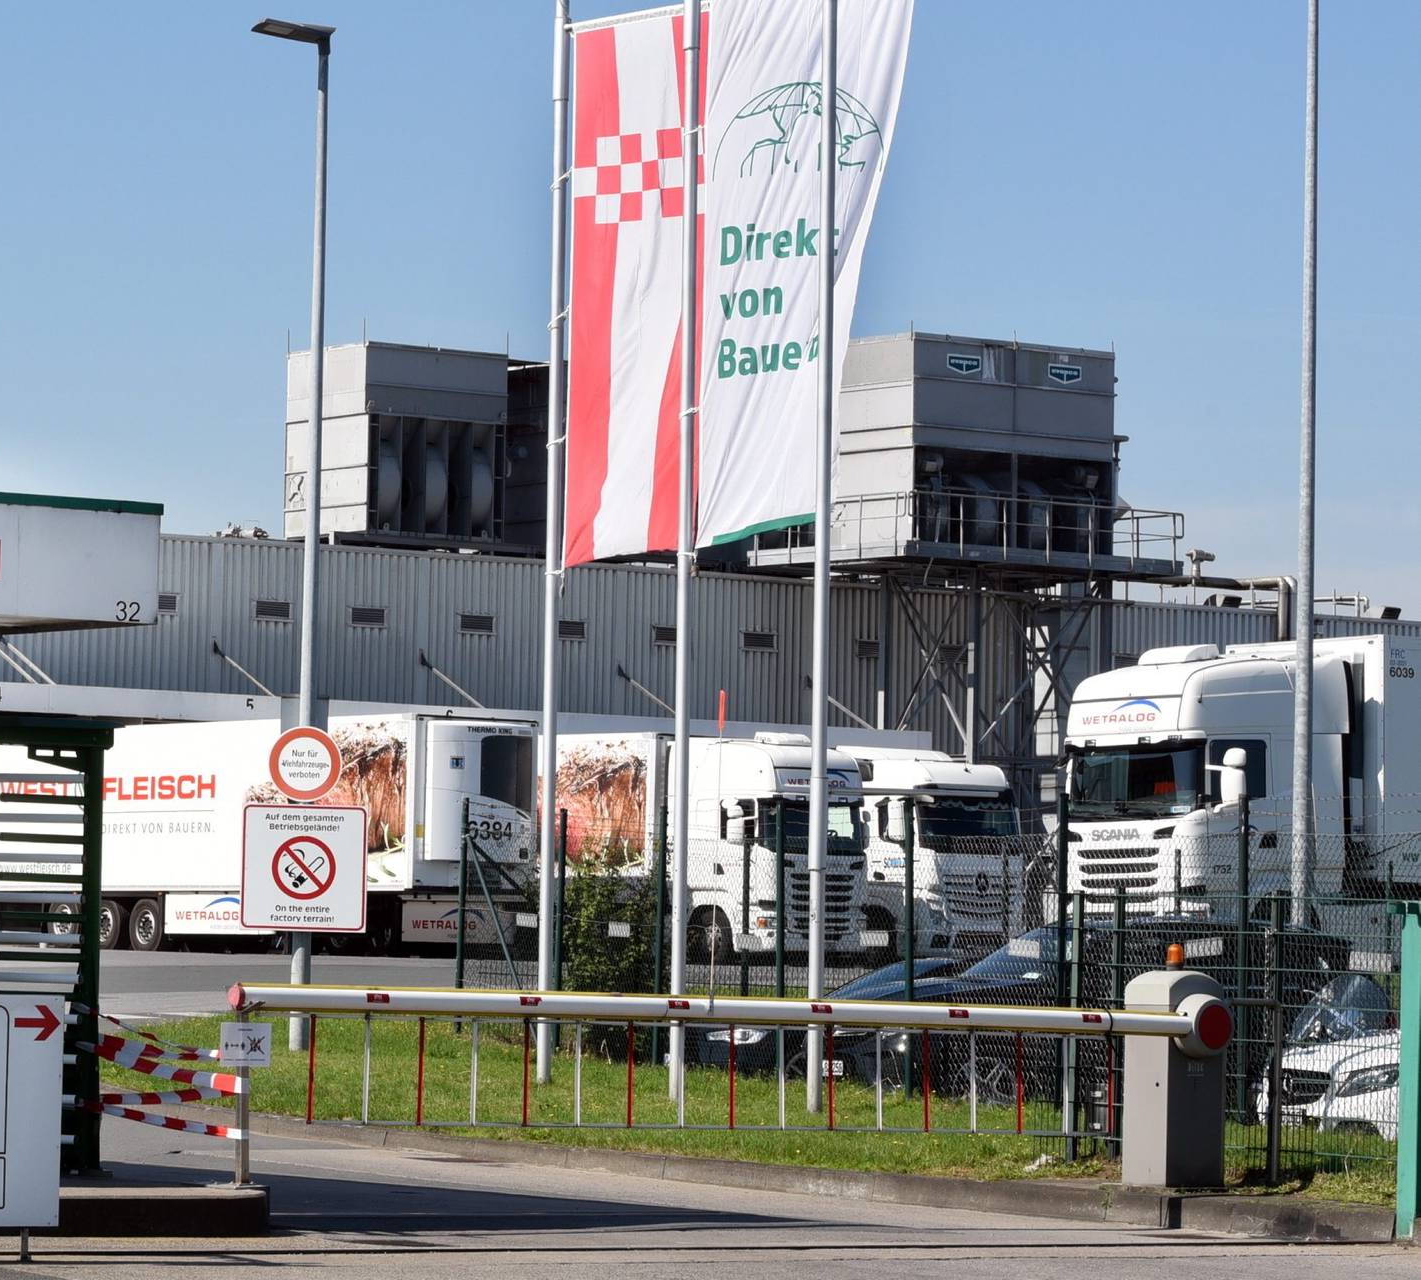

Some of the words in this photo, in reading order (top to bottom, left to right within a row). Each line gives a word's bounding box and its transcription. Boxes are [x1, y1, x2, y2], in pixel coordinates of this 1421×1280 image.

[719, 285, 783, 321] von
[115, 601, 141, 622] 32
[1389, 666, 1415, 679] 6039
[1082, 712, 1156, 725] WETRALOG
[467, 726, 496, 734] THERMO
[291, 749, 305, 757] Nur
[307, 749, 318, 757] für
[288, 771, 320, 779] verboten
[102, 774, 216, 801] FLEISCH
[787, 778, 846, 788] WETOG
[265, 812, 279, 821] Auf
[282, 813, 301, 821] dem
[303, 814, 345, 823] gesamten
[141, 823, 163, 833] VON
[169, 822, 215, 833] BAUERN.
[269, 822, 340, 832] Betriebsgelände!
[1091, 828, 1140, 842] SCANIA
[275, 904, 287, 912] On
[289, 904, 303, 913] the
[305, 905, 330, 914] entire
[175, 911, 239, 920] WETRALOG
[270, 913, 300, 923] factory
[303, 915, 334, 923] terrain!
